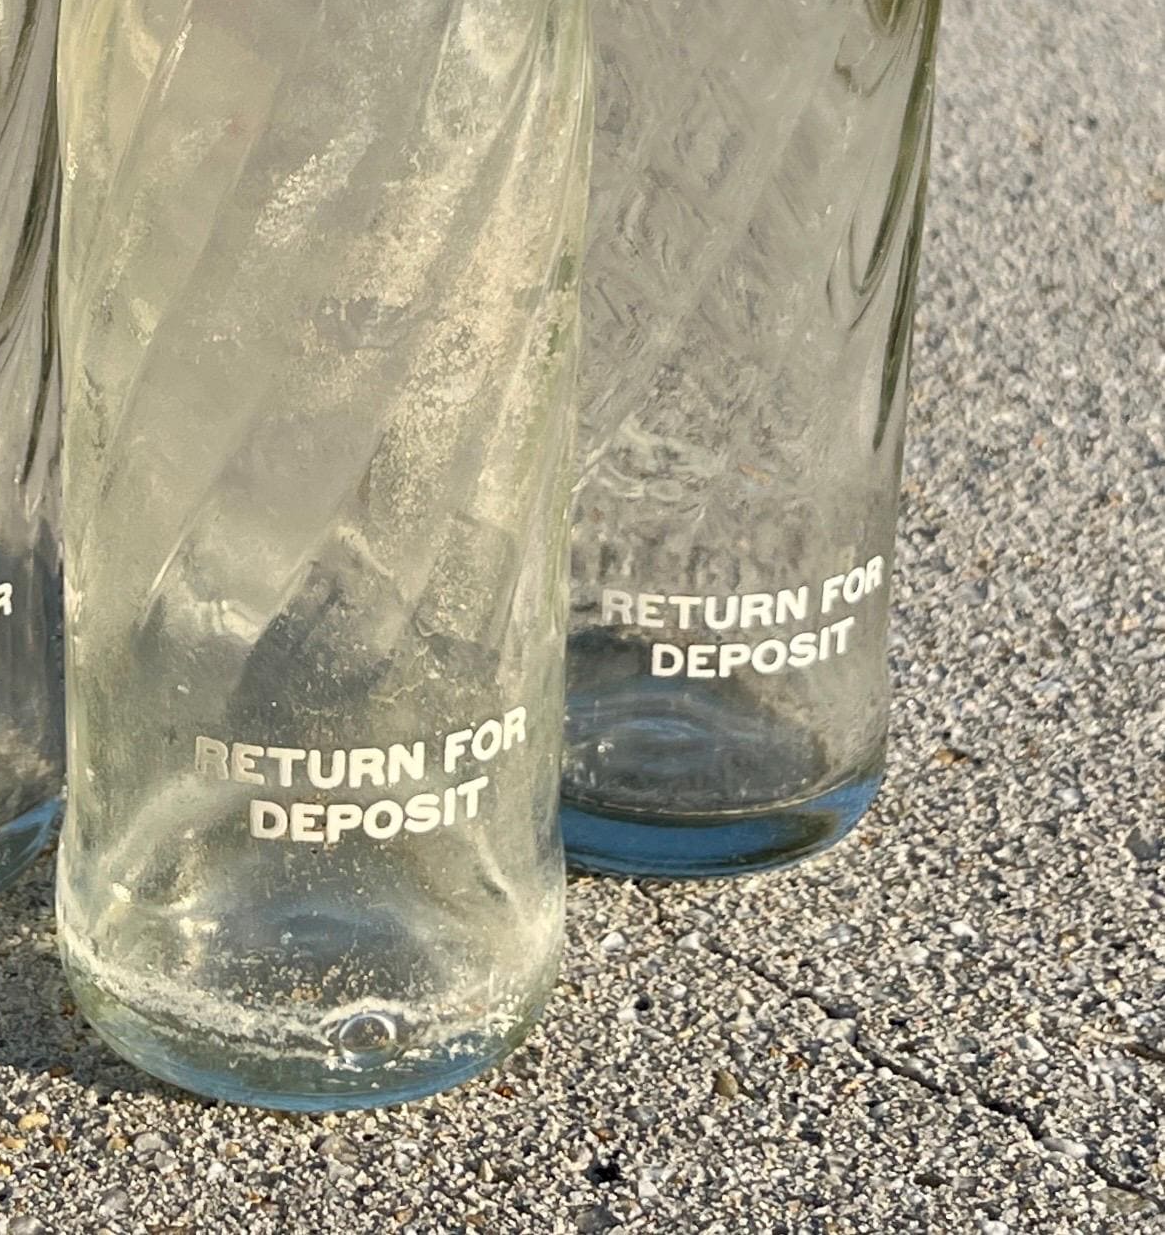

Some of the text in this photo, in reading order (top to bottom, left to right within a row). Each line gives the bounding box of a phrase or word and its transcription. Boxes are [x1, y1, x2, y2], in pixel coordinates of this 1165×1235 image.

[601, 555, 884, 630] RETURN FOR
[651, 616, 855, 678] DEPOSIT
[195, 706, 527, 789] RETURN FOR
[249, 776, 489, 843] DEPOSIT
